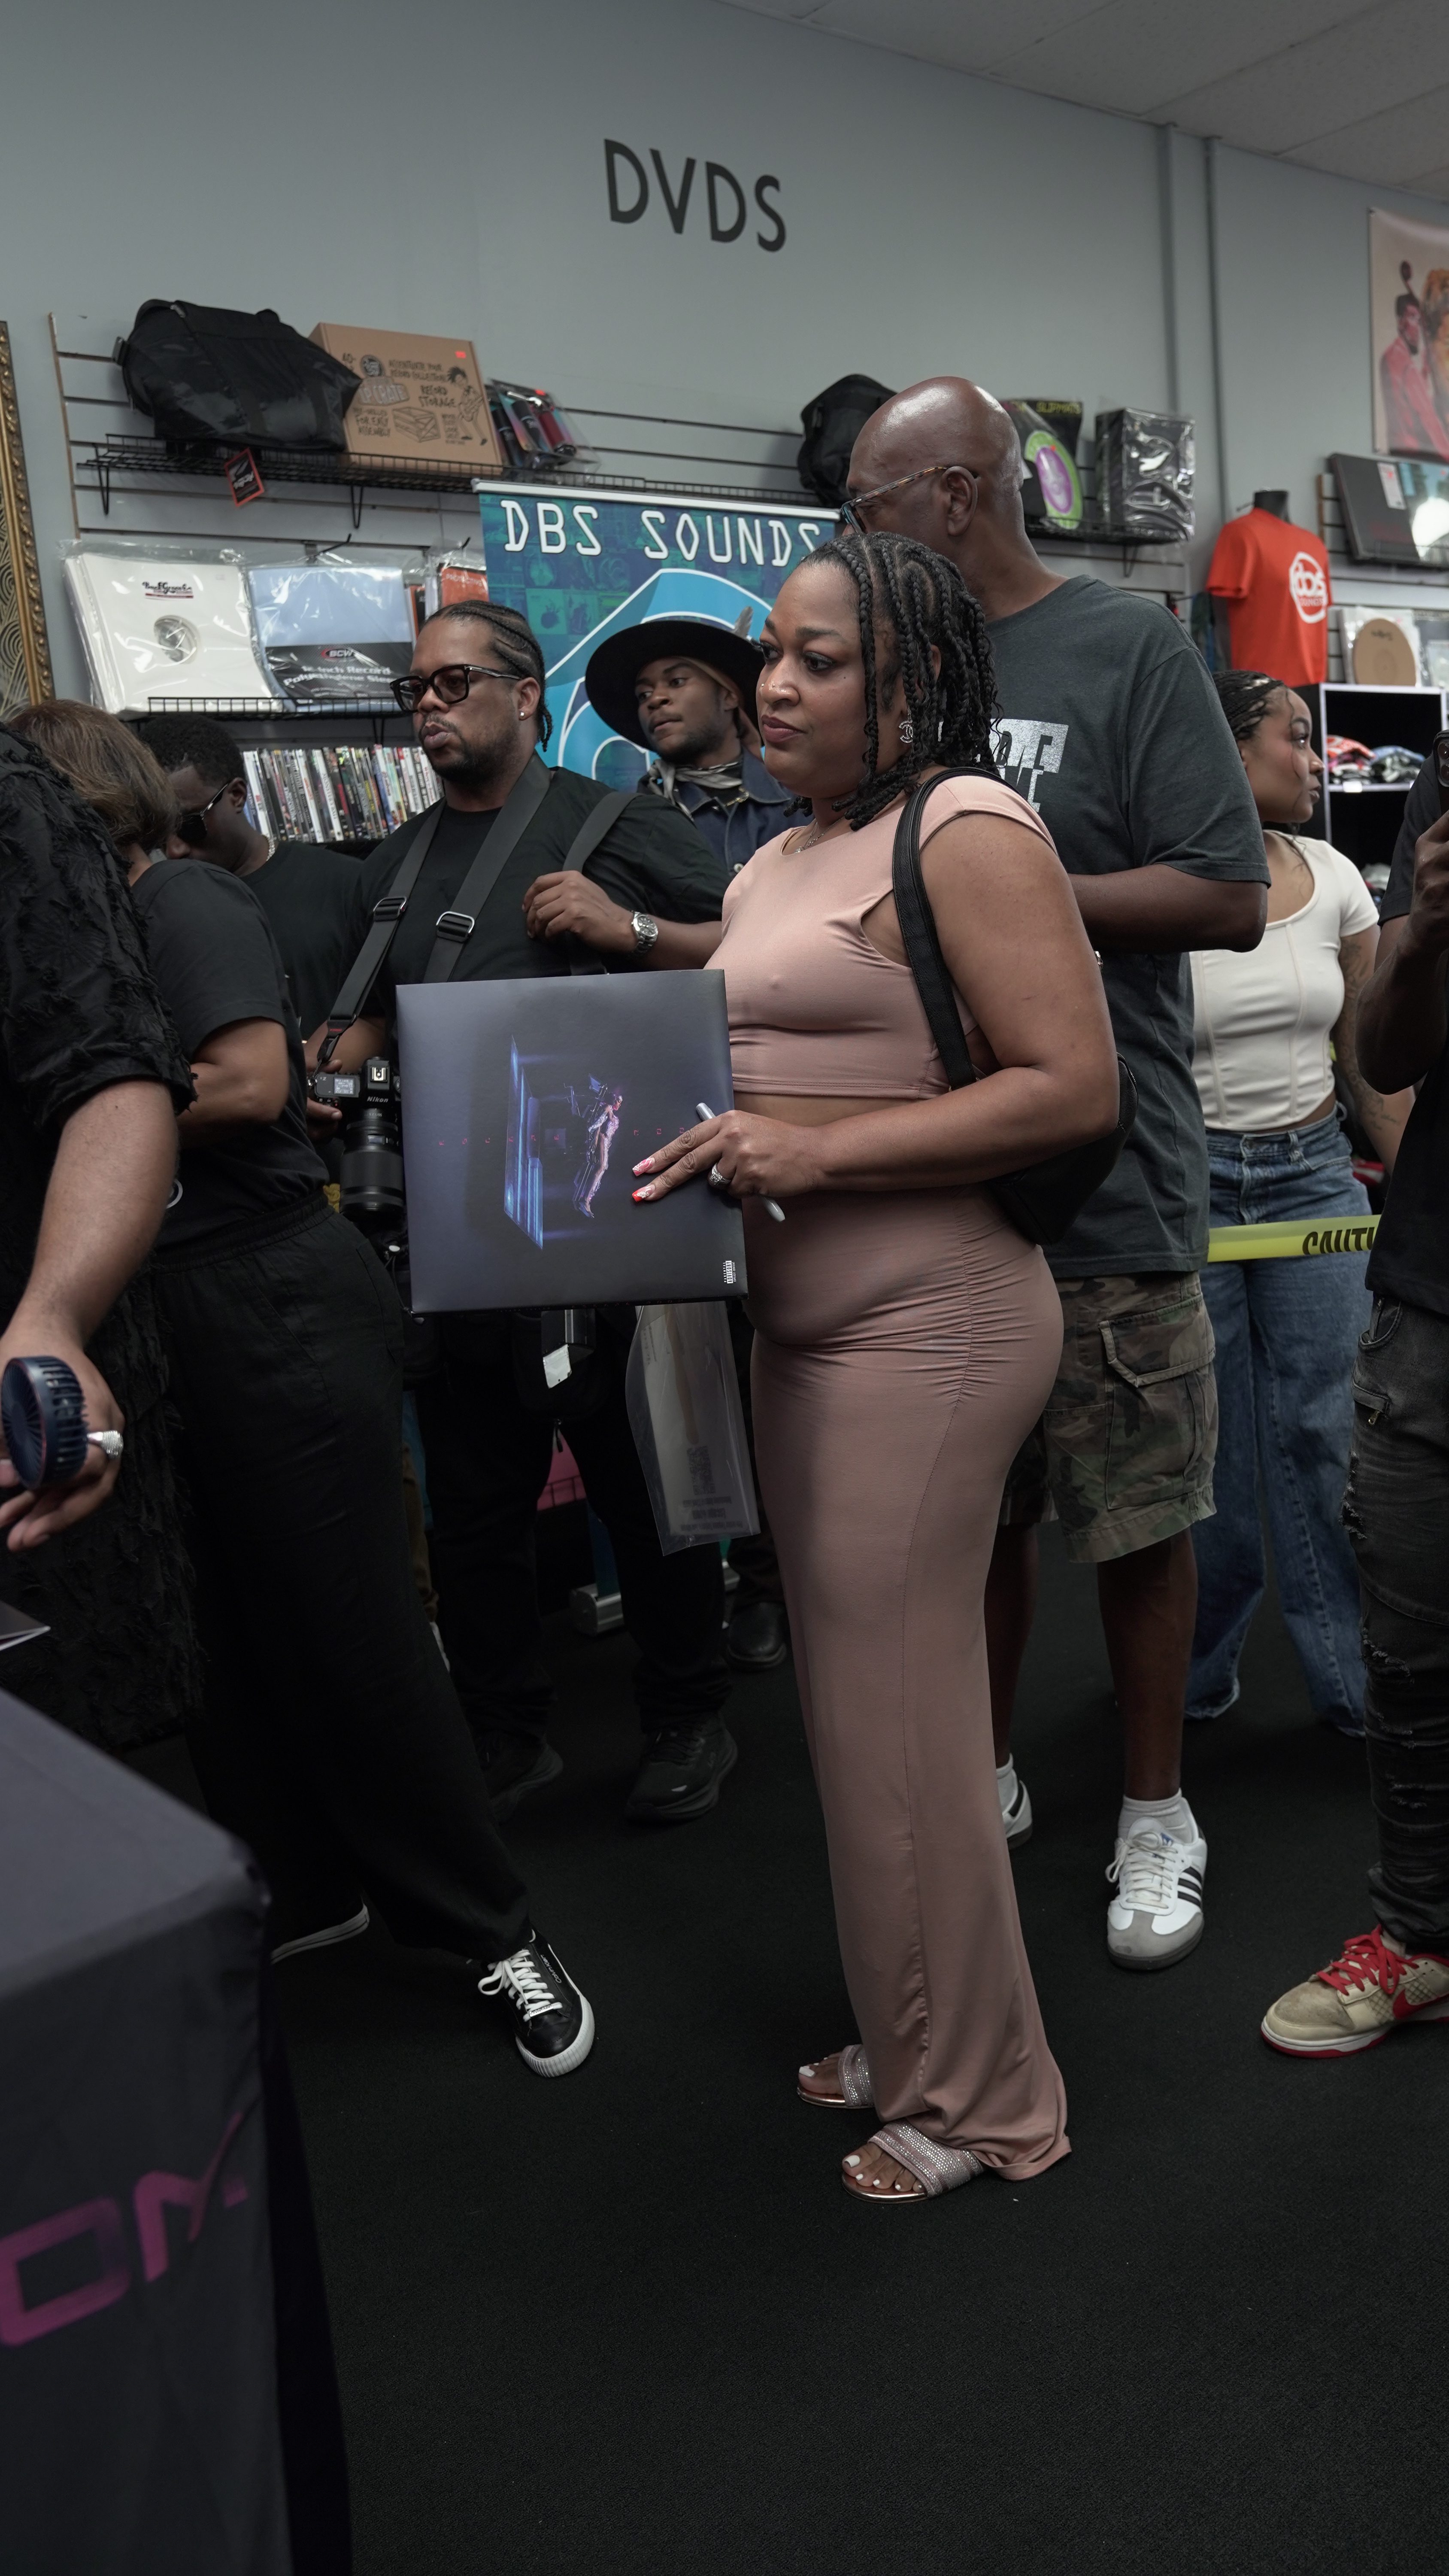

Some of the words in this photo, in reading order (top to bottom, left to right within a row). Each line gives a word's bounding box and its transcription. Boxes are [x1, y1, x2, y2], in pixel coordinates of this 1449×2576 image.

[603, 138, 787, 252] DVDS
[500, 499, 602, 556] DBS
[641, 510, 821, 566] SOUNDS
[329, 649, 354, 657] BCW
[347, 667, 392, 675] Record
[633, 1127, 685, 1136] ROO
[1302, 1227, 1375, 1255] CAUTI
